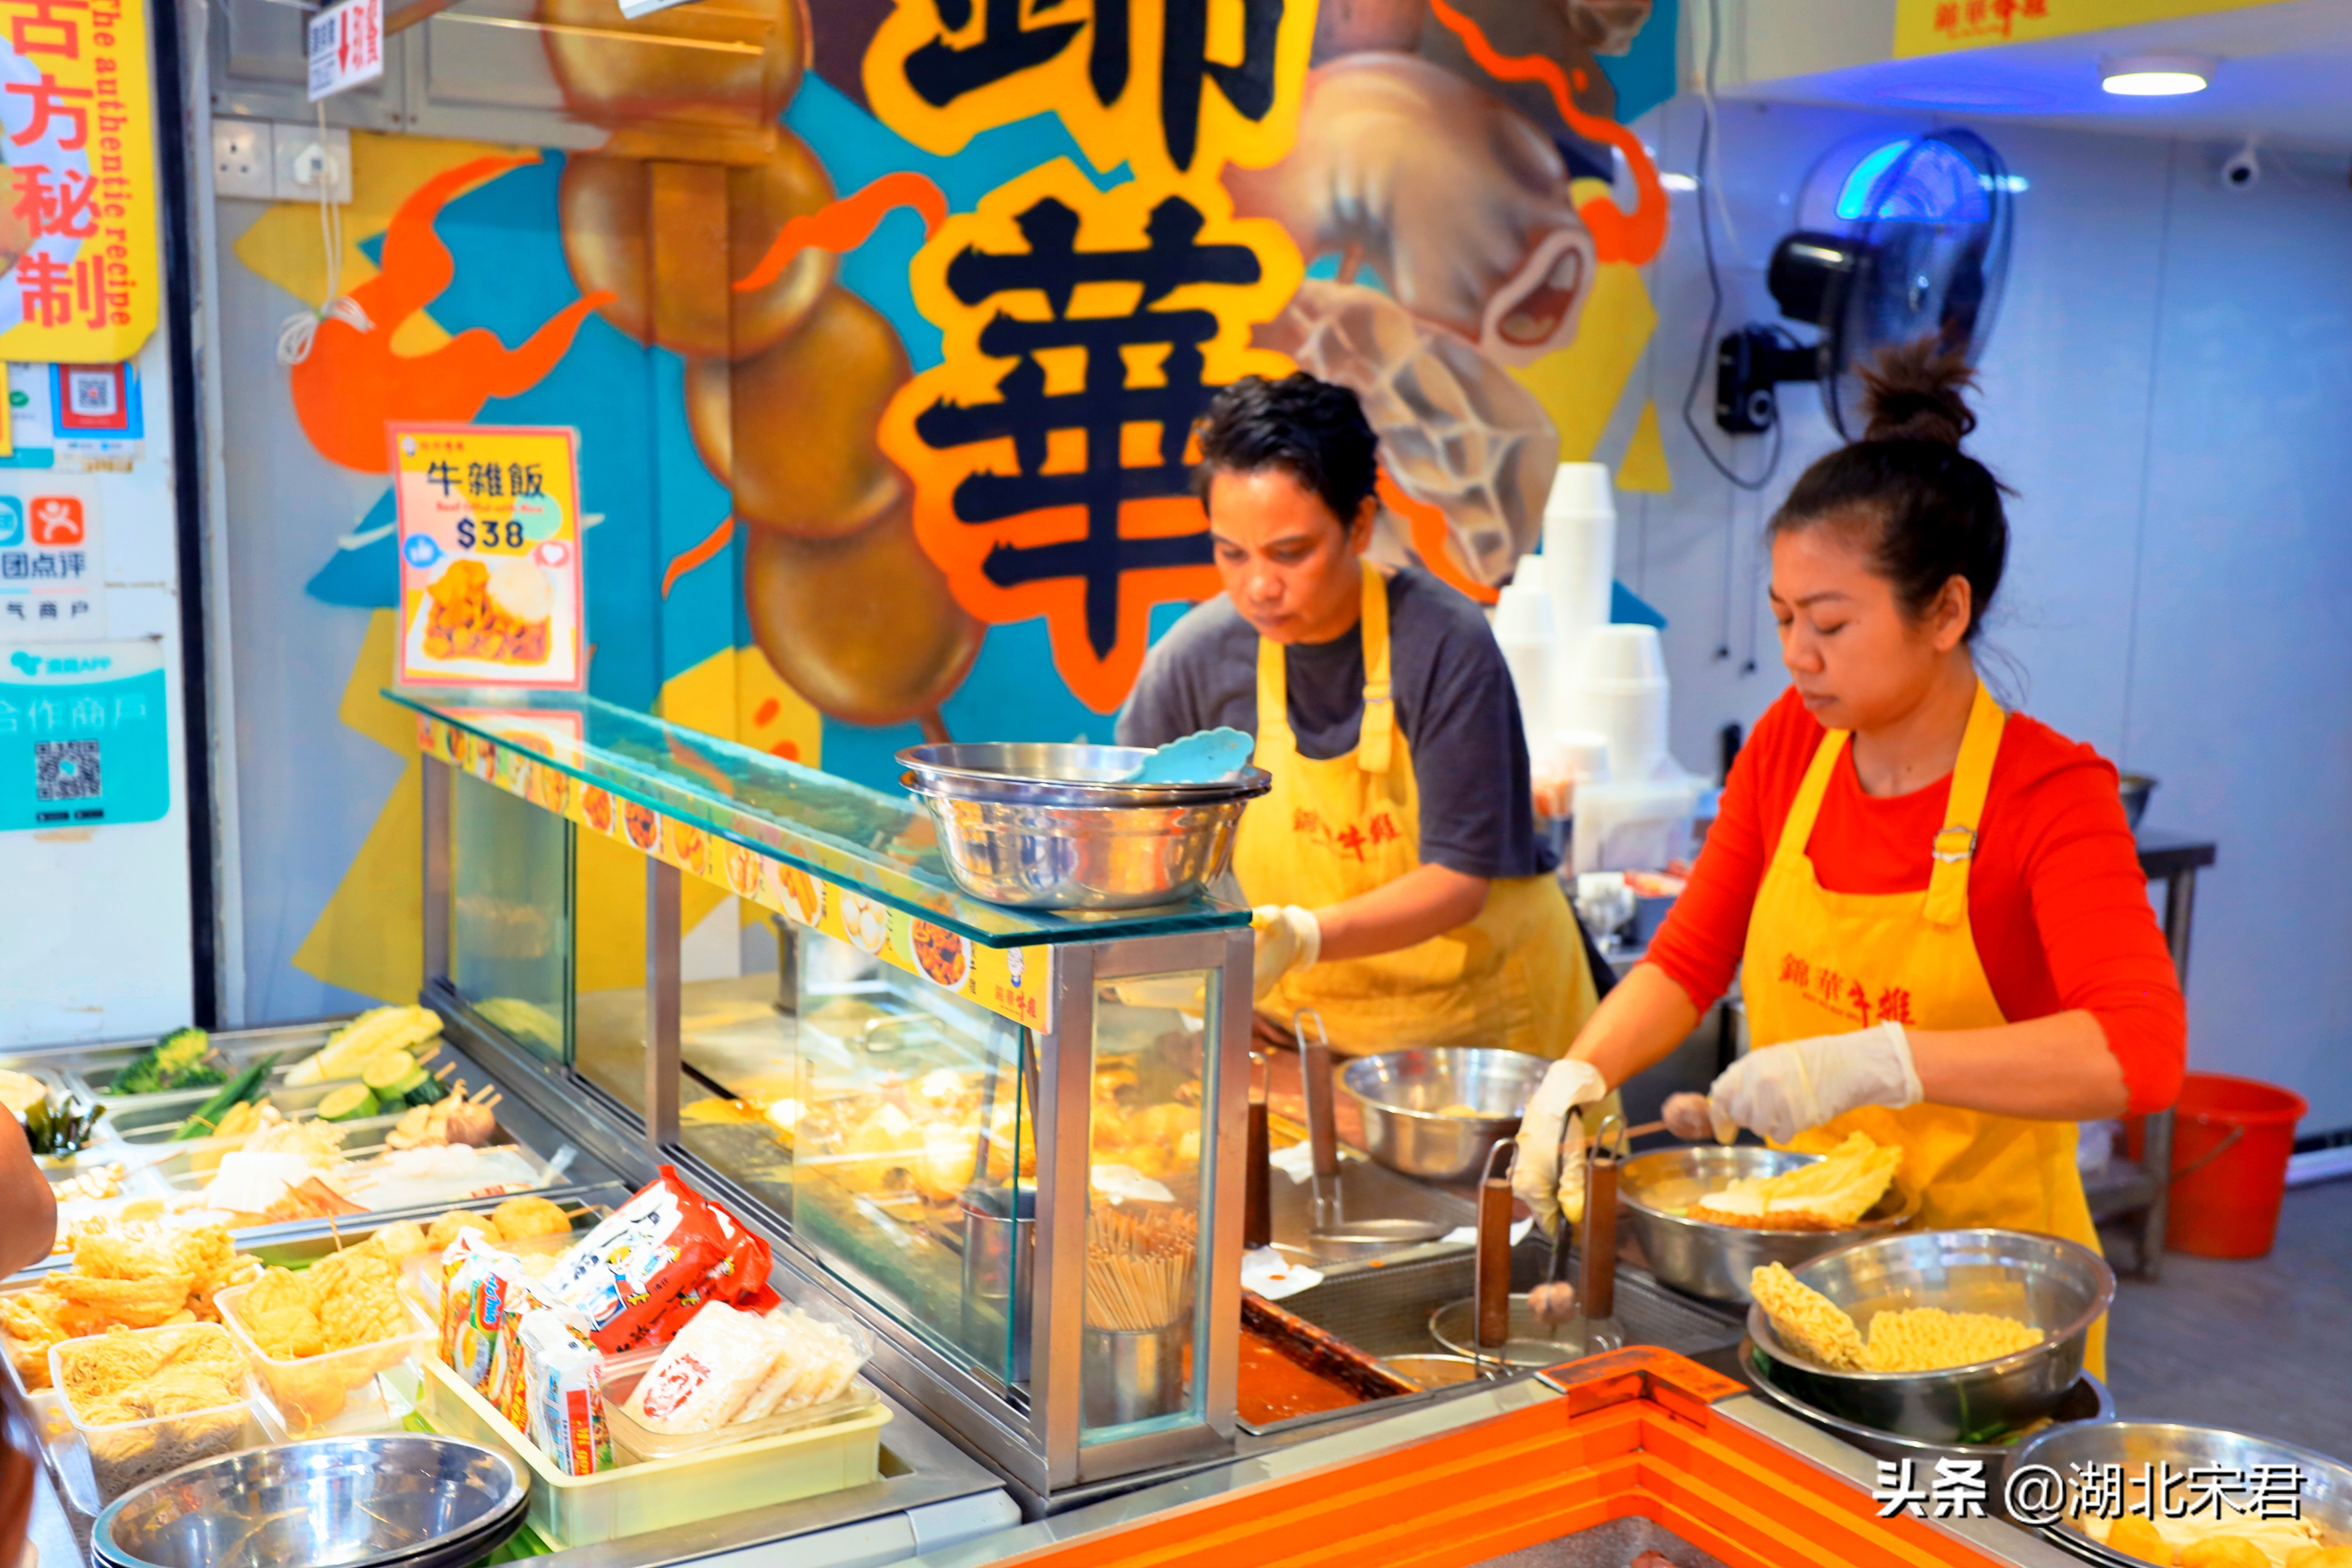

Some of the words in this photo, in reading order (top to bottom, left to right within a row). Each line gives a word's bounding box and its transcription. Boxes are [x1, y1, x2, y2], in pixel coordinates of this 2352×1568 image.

[94, 57, 133, 218] authentic
[105, 227, 138, 326] recipe
[427, 460, 546, 499] 牛雜飯
[457, 517, 524, 550] $38
